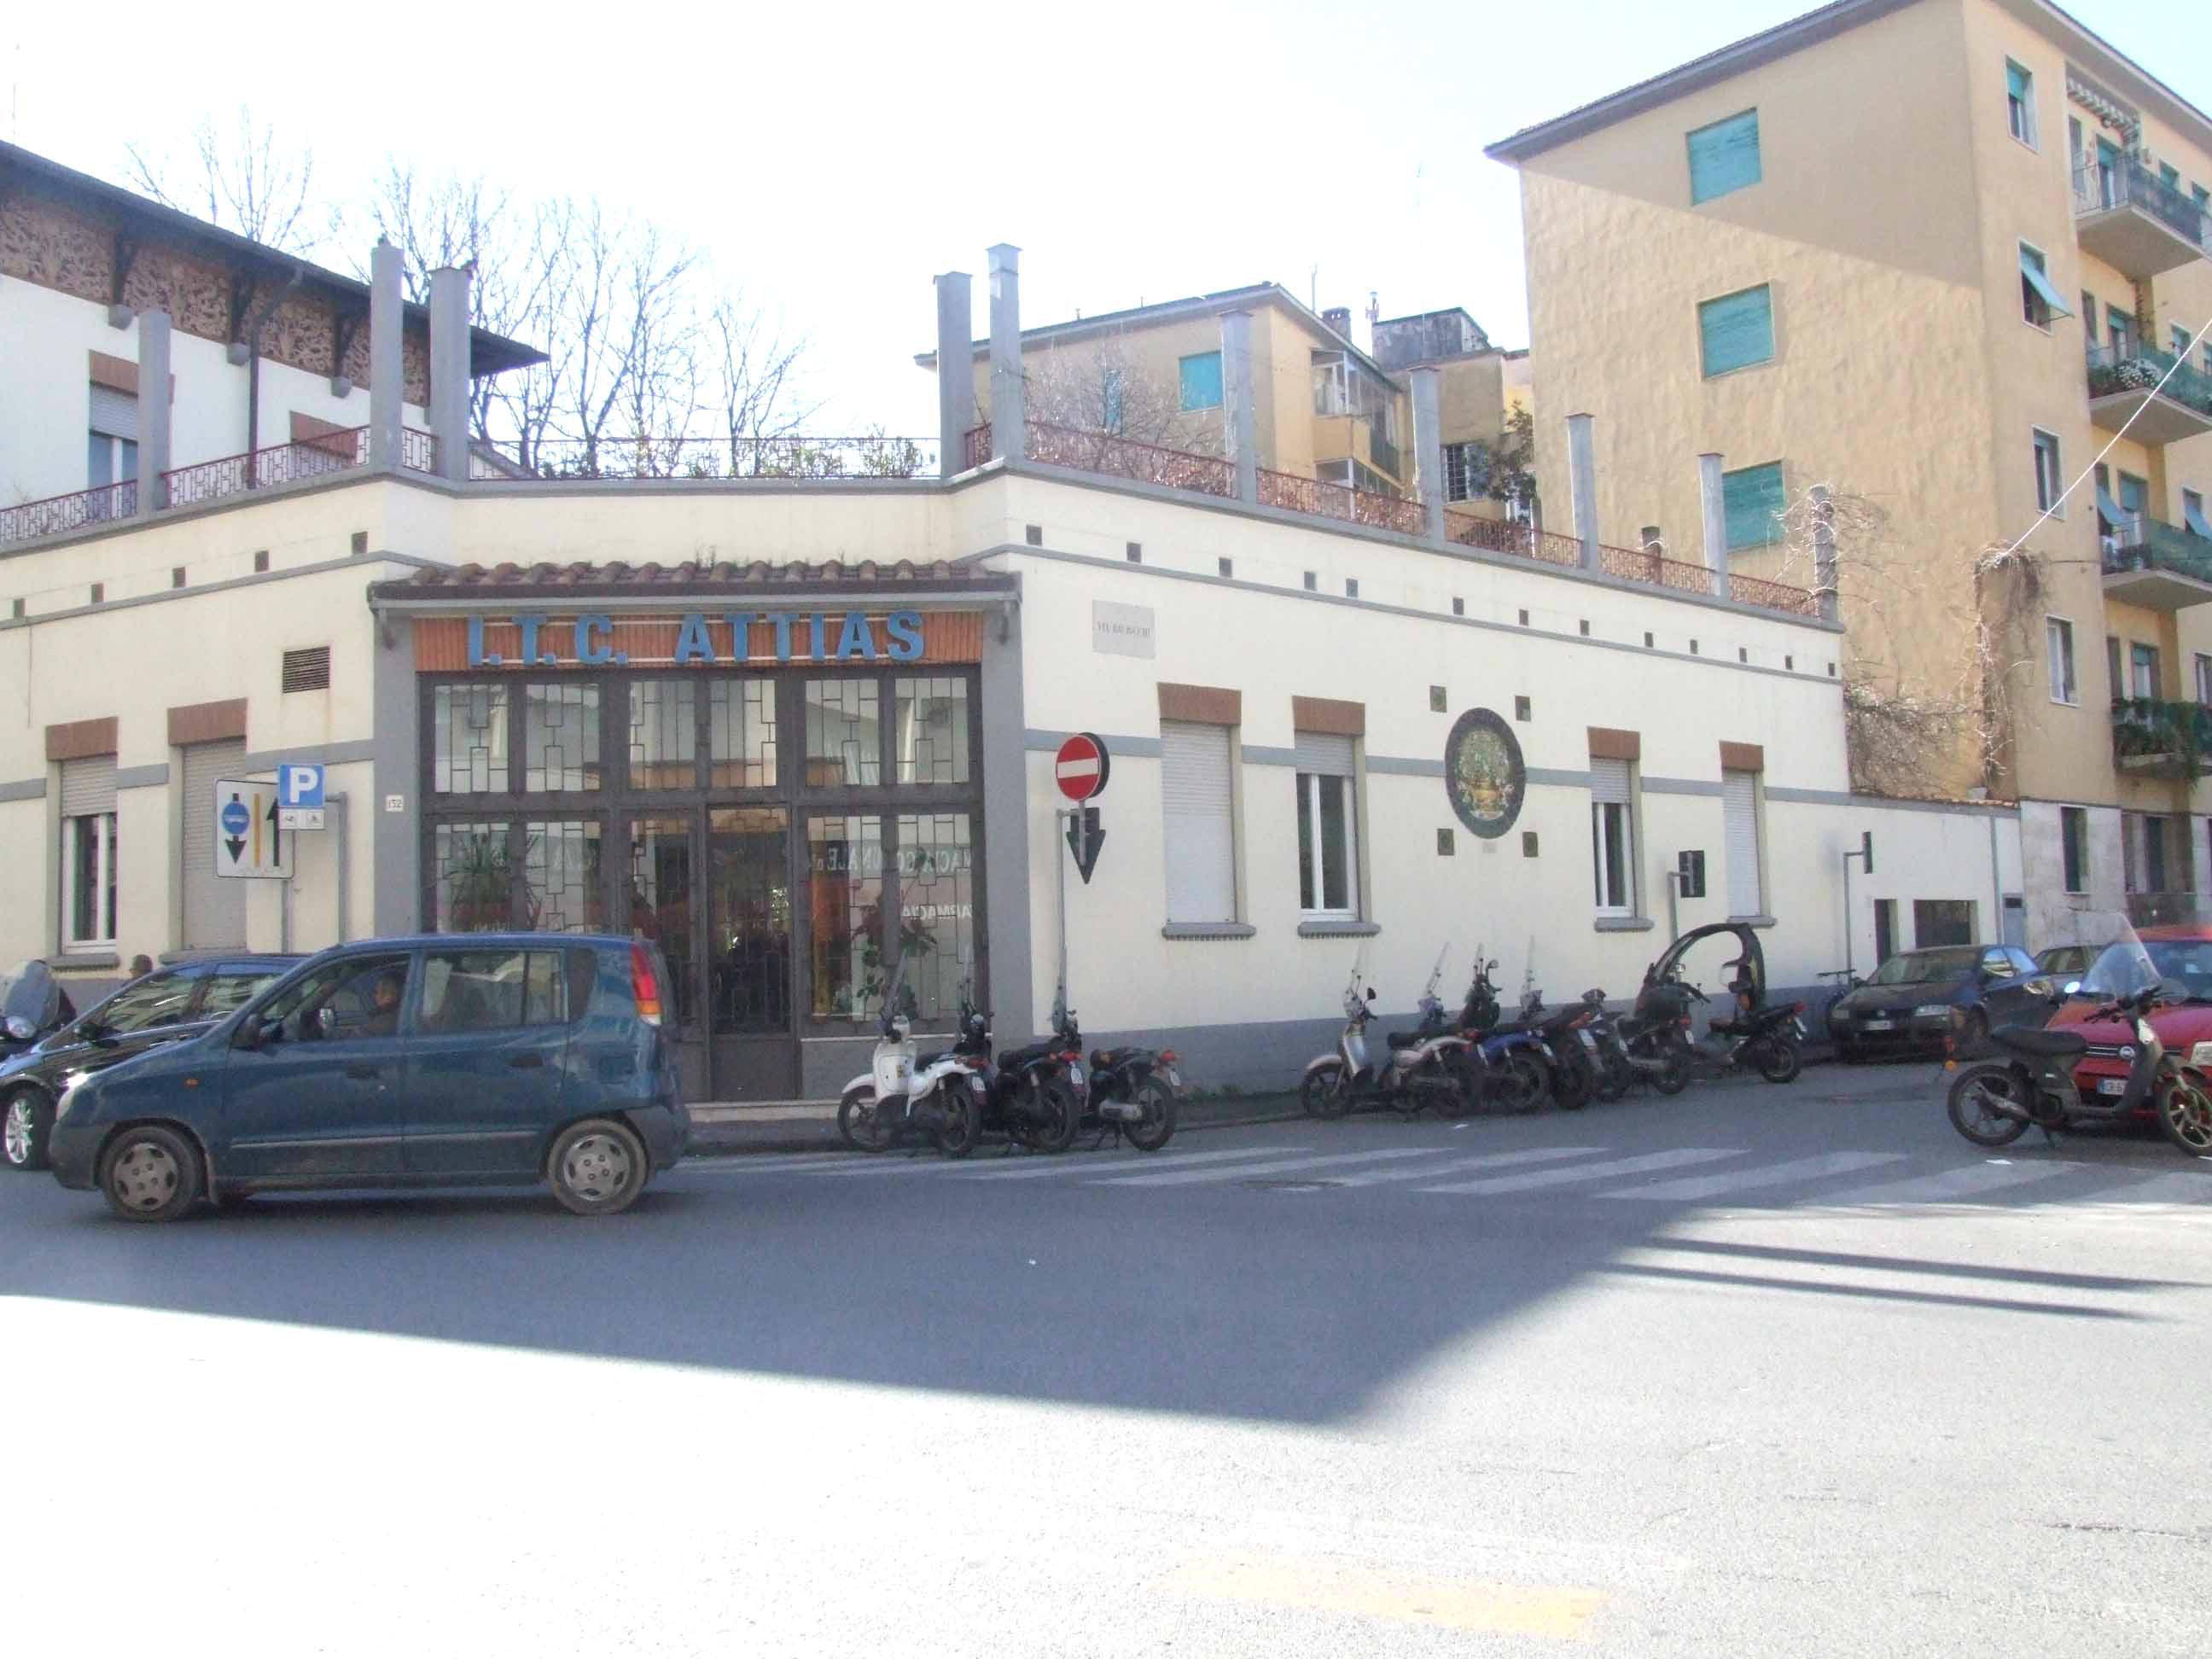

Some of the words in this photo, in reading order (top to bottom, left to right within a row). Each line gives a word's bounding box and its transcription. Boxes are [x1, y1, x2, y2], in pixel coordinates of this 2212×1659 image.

[469, 614, 628, 667] I.T.C.
[674, 610, 924, 663] ATTIAS
[289, 767, 318, 803] P
